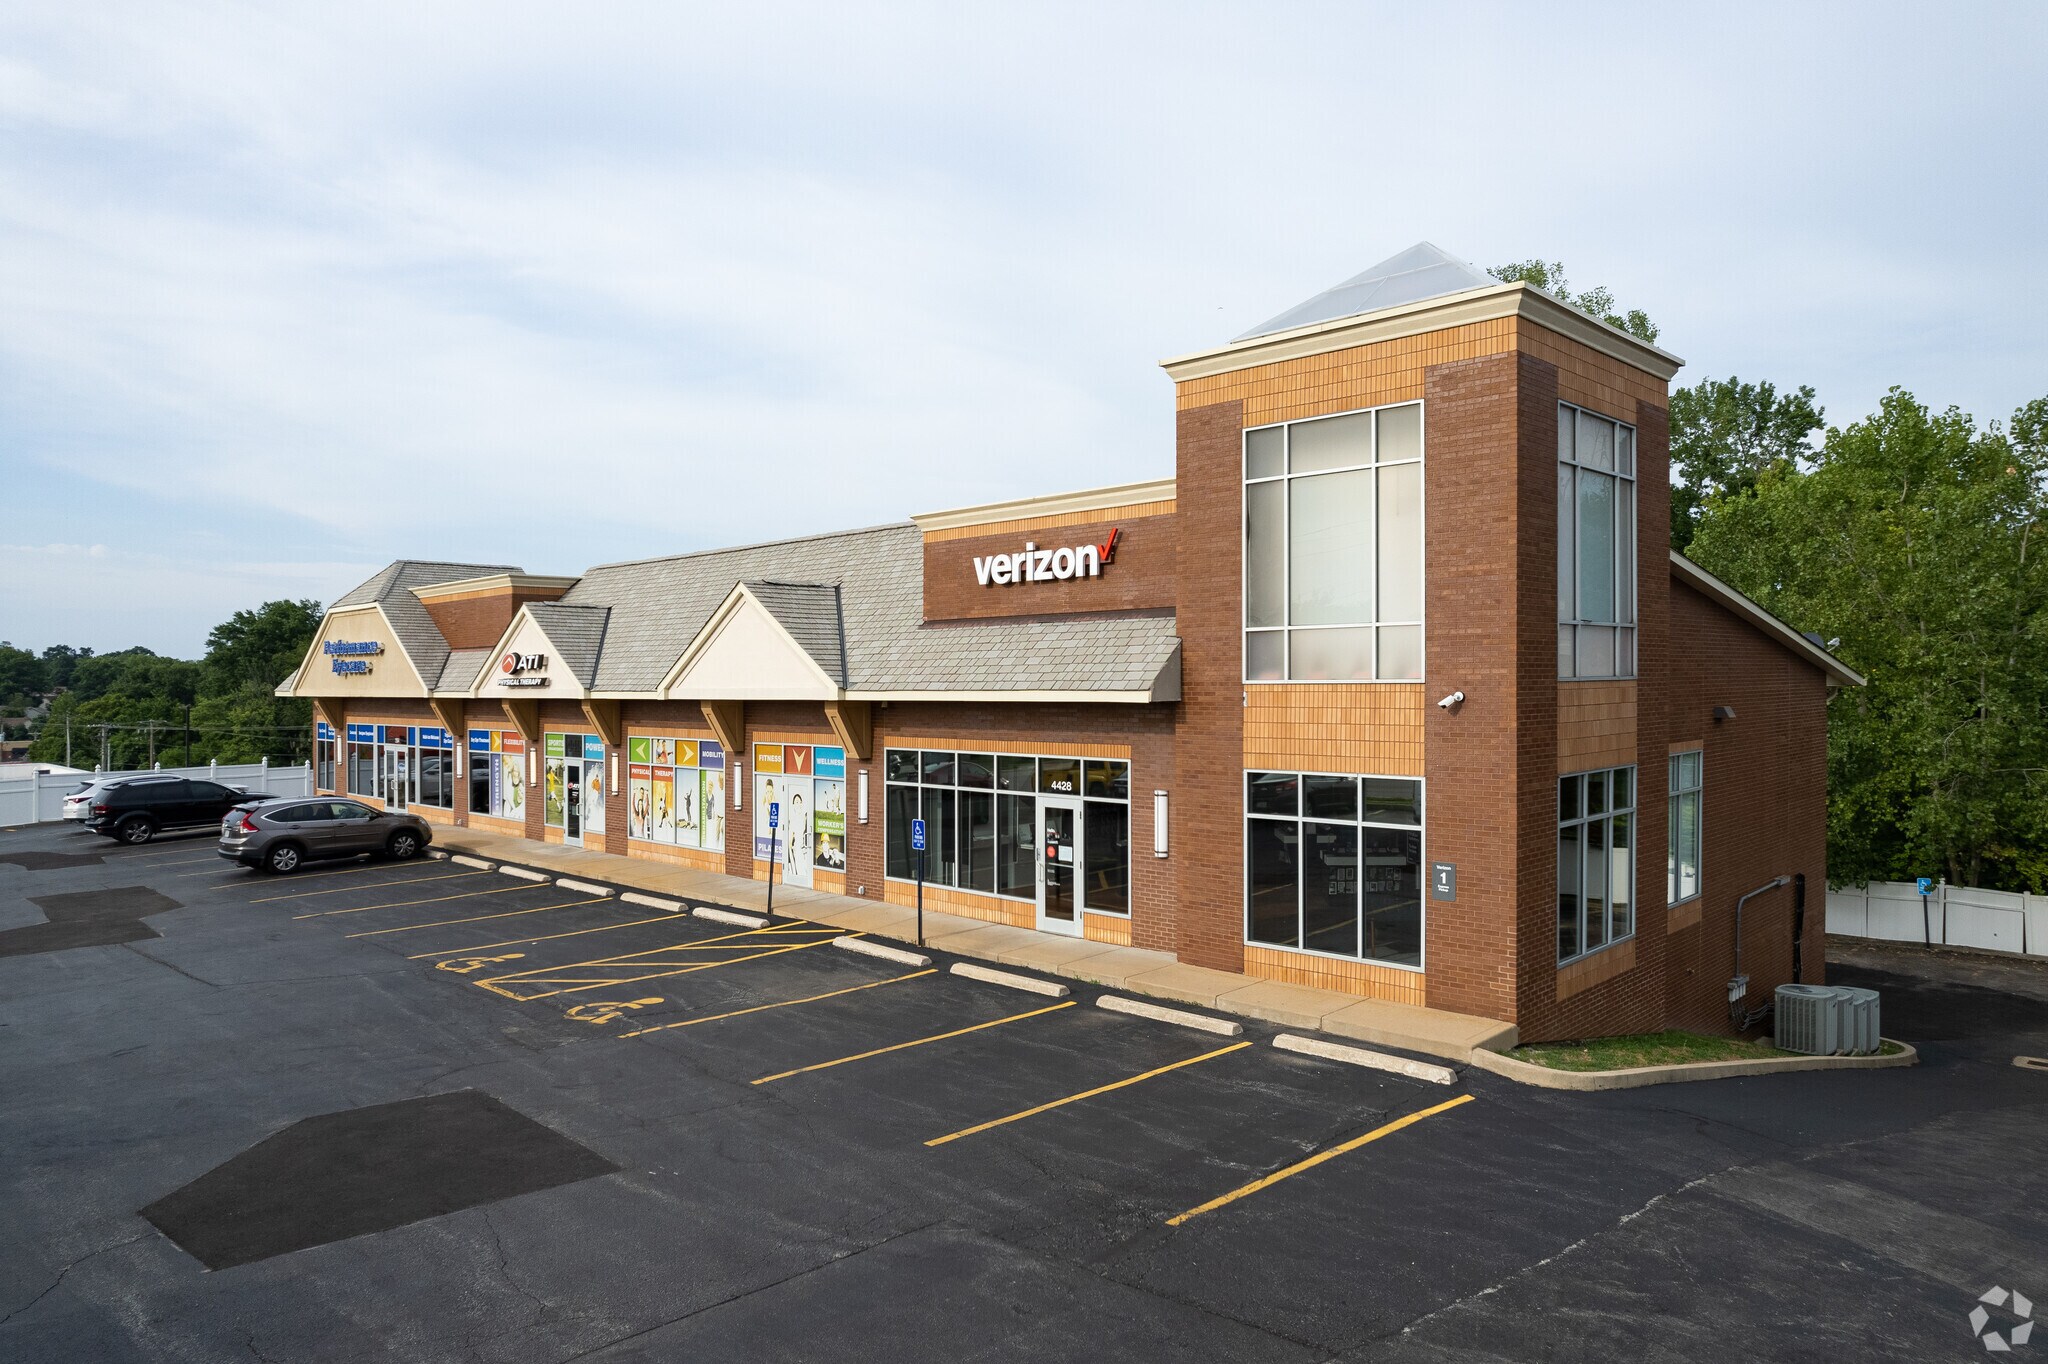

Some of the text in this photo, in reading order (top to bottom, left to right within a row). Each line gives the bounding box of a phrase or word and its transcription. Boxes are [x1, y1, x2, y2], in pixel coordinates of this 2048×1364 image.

[973, 541, 1099, 586] verizon
[323, 639, 378, 655] Performance
[332, 658, 366, 676] Eyecare
[517, 655, 541, 670] ATI
[497, 677, 542, 686] PHYSICAL THERAPY
[503, 738, 524, 746] FLEXIBILITY
[702, 750, 724, 759] MOBILITY
[758, 754, 782, 763] FITNESS
[816, 757, 844, 767] WELLNESS
[631, 768, 650, 776] PHYSICAL
[654, 769, 673, 778] THERAPY
[1051, 780, 1072, 791] 4428
[758, 842, 782, 854] PILAES
[1440, 872, 1446, 884] 1
